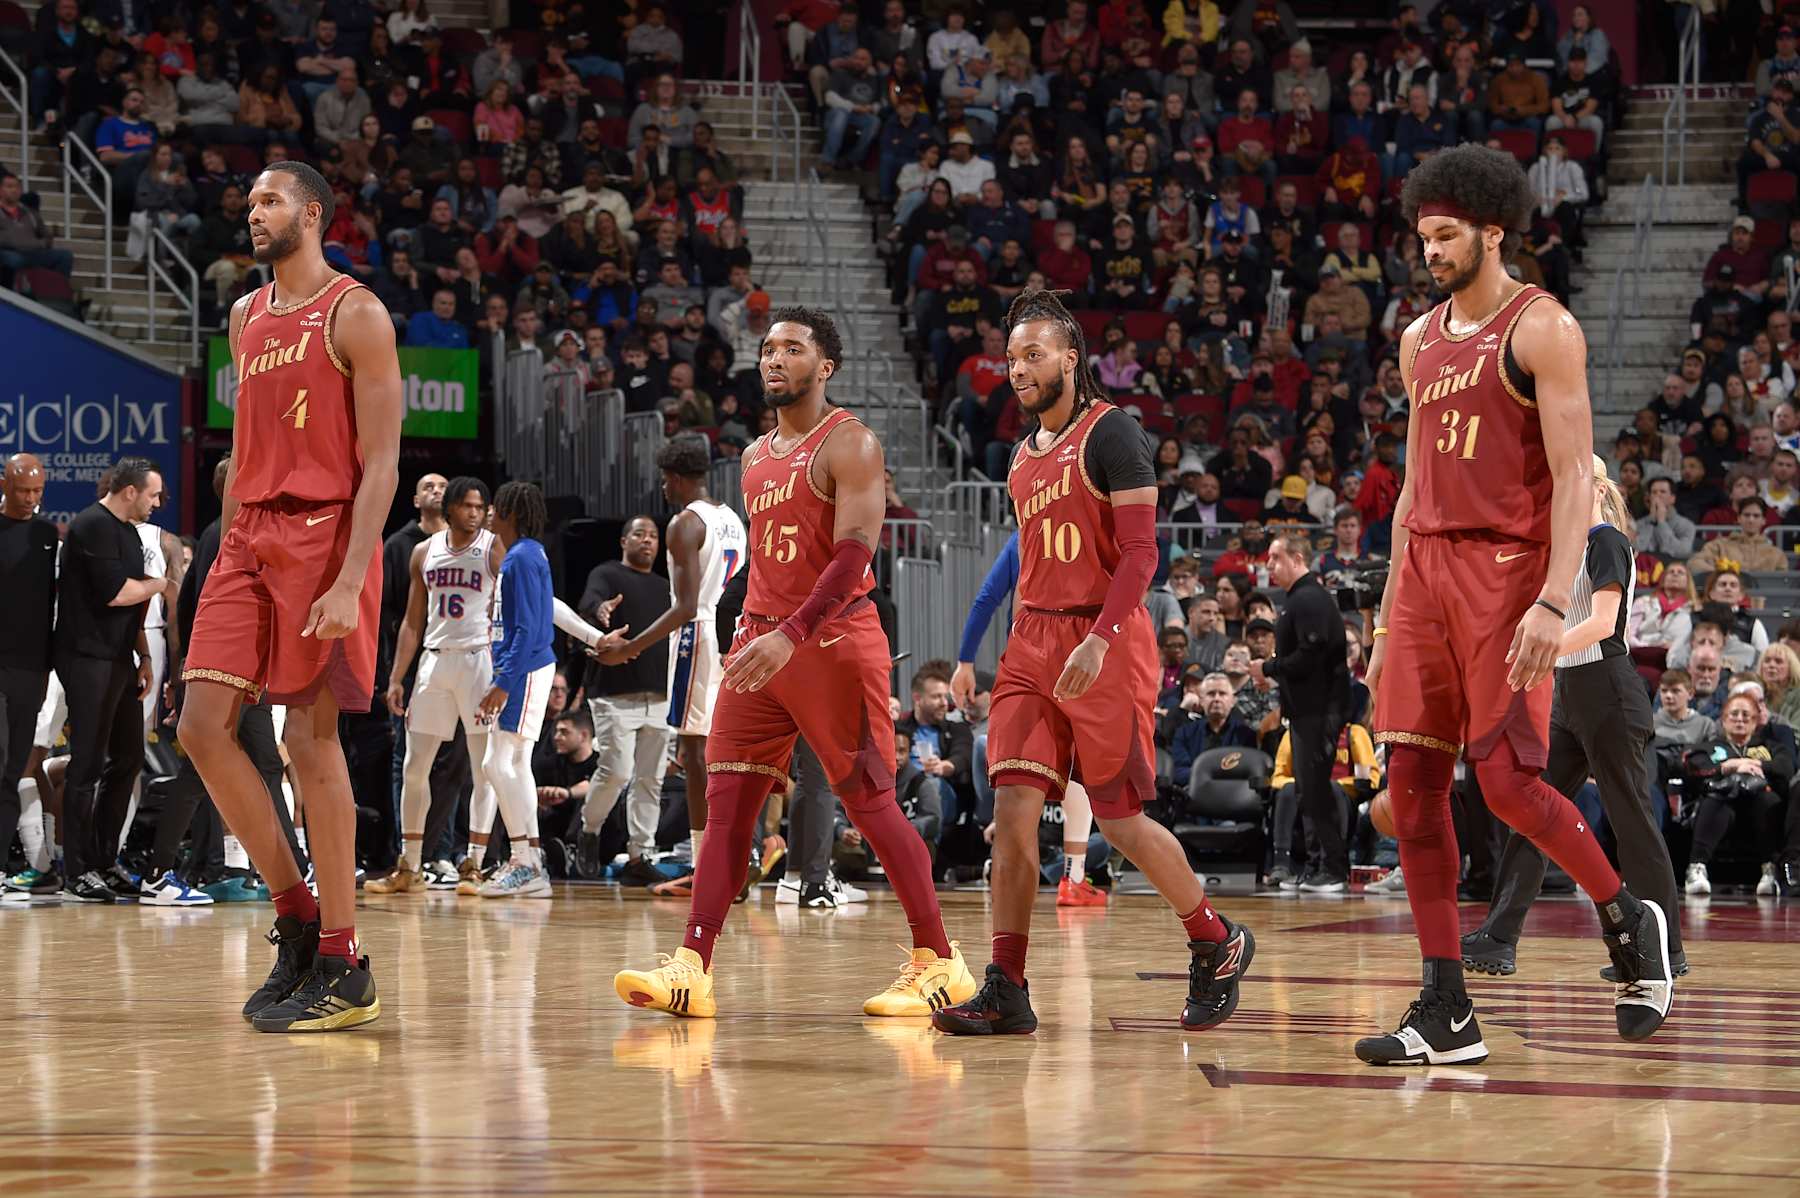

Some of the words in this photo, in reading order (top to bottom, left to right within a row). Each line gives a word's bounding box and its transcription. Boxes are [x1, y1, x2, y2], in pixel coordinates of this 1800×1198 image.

[239, 332, 312, 384] Land
[264, 337, 281, 349] The
[1411, 354, 1487, 412] Land
[1438, 364, 1457, 378] The
[280, 389, 311, 429] 4
[1436, 409, 1480, 461] 31
[54, 455, 110, 467] COLLEGE
[1057, 454, 1078, 462] CLIFFS
[743, 470, 798, 517] Land
[763, 479, 777, 491] The
[1014, 464, 1073, 528] Land
[1032, 478, 1046, 492] The
[756, 519, 799, 564] 45
[1038, 517, 1081, 563] 10
[426, 567, 482, 593] PHILA
[722, 549, 739, 590] 7
[438, 592, 465, 620] 16
